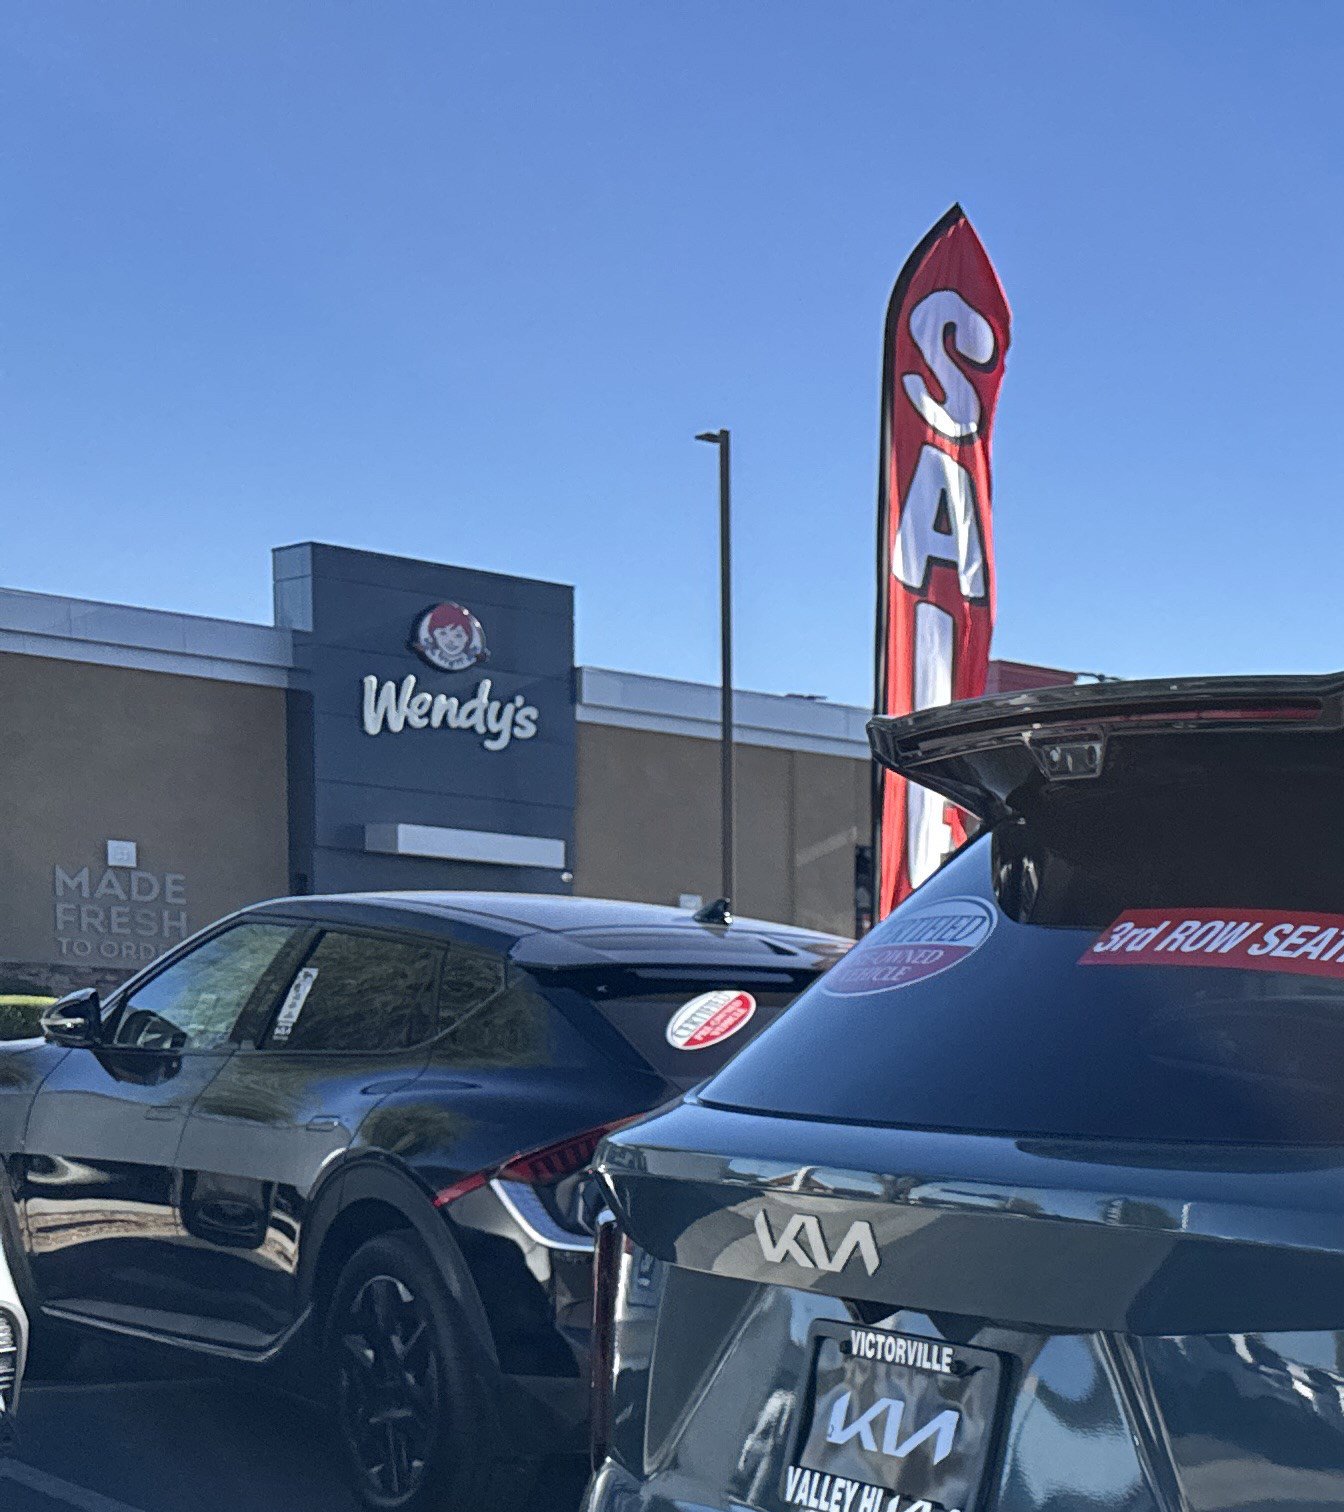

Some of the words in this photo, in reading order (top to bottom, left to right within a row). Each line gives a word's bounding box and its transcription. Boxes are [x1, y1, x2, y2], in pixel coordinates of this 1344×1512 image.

[363, 674, 539, 751] Wendy's
[54, 864, 187, 905] MADE
[55, 903, 188, 938] FRESH
[1093, 920, 1171, 952] 3rd
[1154, 920, 1263, 953] ROW
[57, 937, 92, 956] TO
[100, 941, 158, 961] ORD
[753, 1208, 882, 1277] KIA
[849, 1329, 955, 1374] VICTORVILLE
[826, 1390, 961, 1467] KIA
